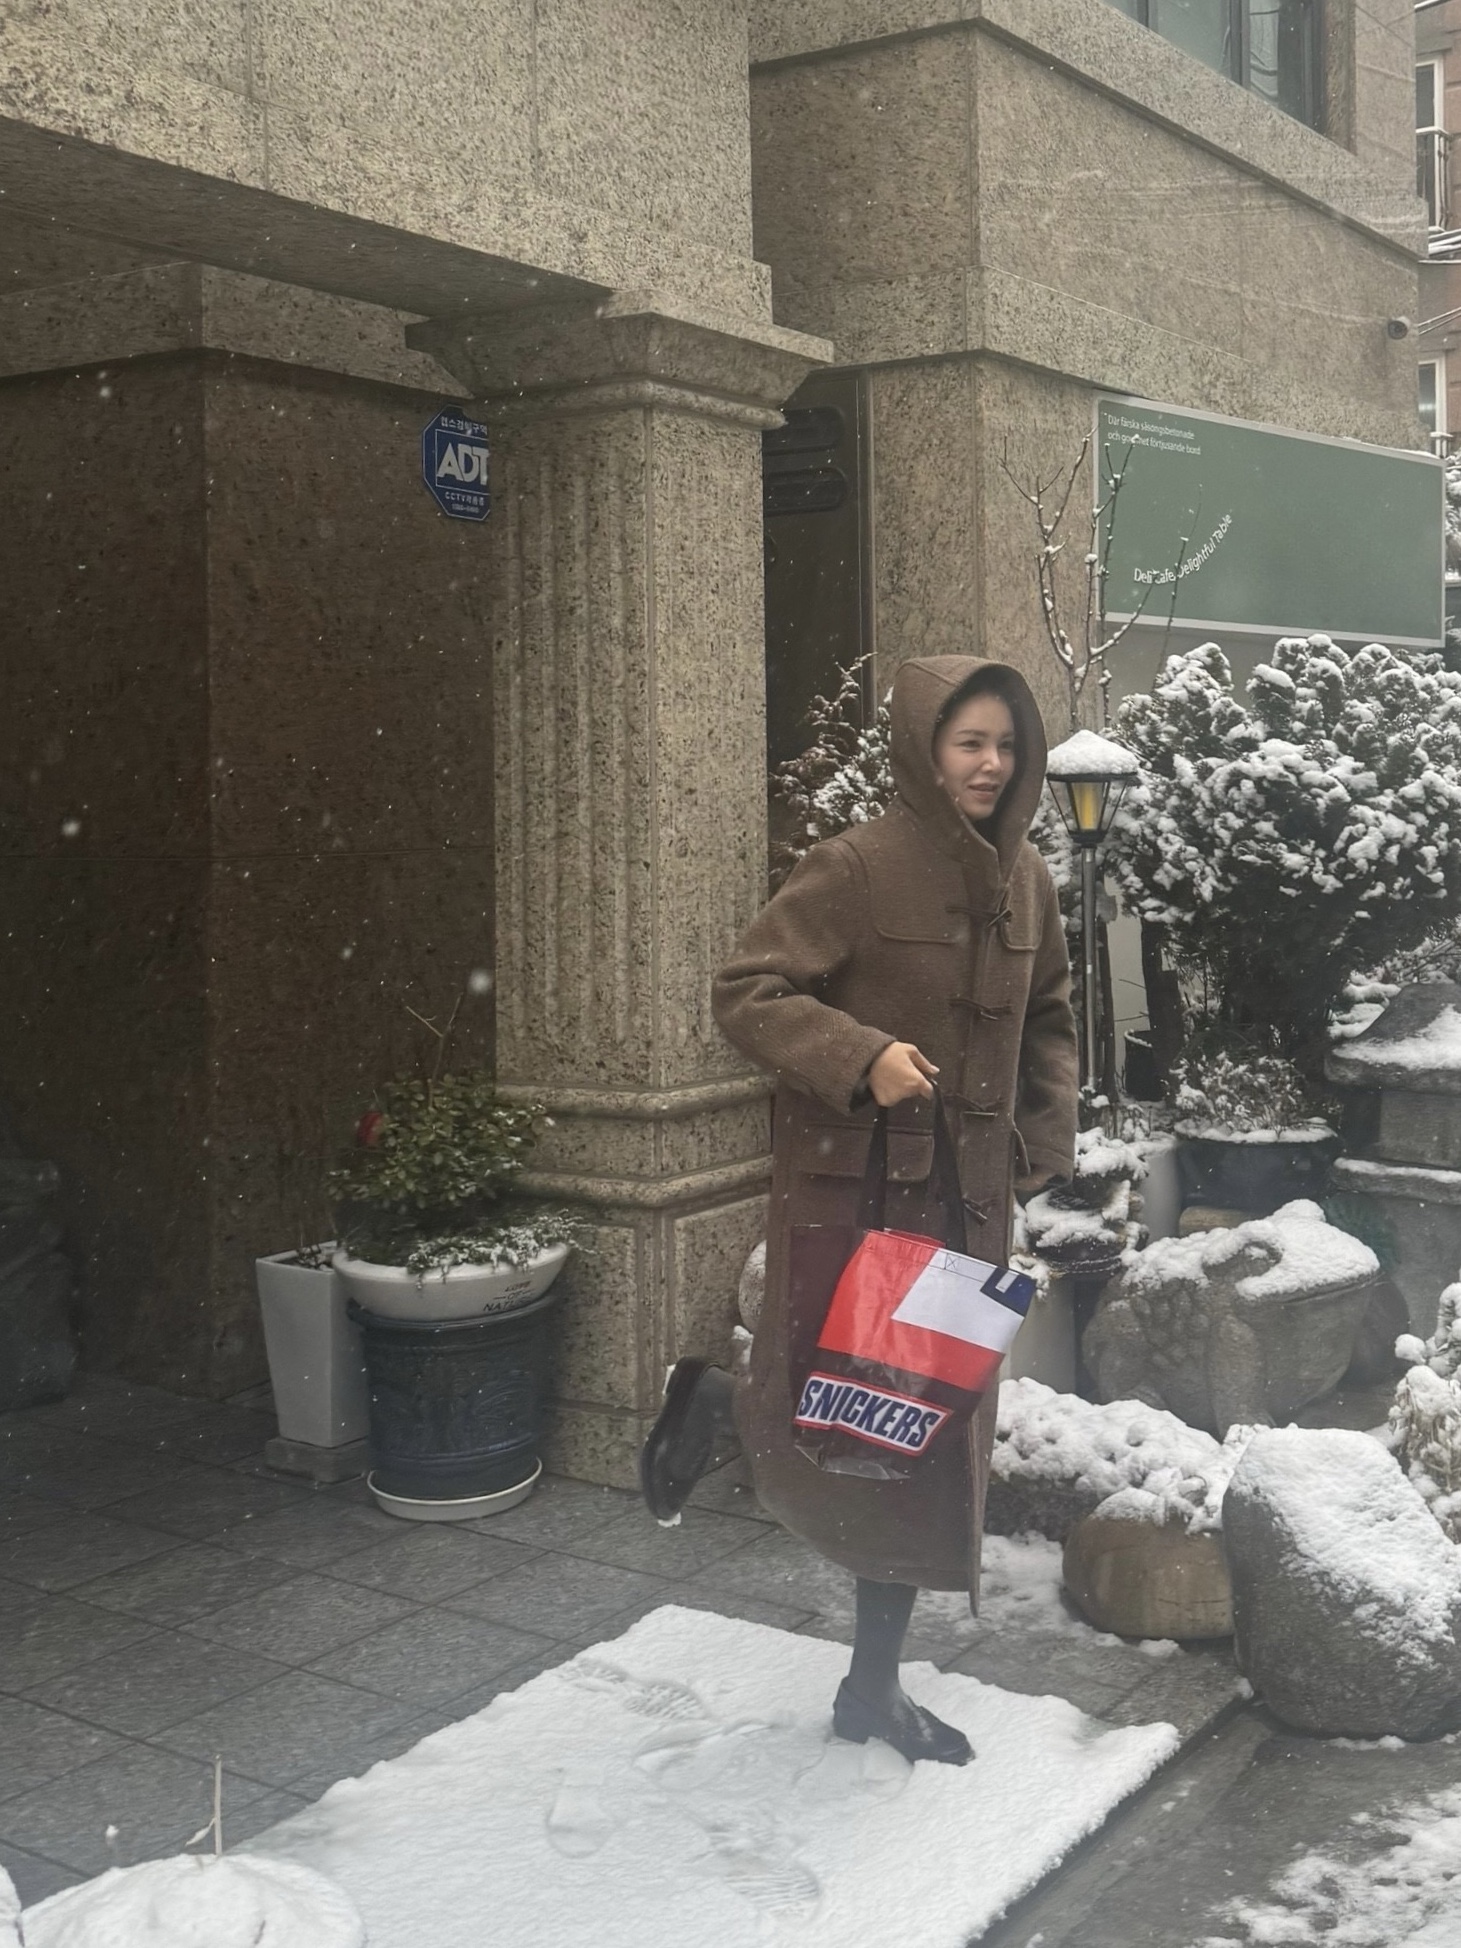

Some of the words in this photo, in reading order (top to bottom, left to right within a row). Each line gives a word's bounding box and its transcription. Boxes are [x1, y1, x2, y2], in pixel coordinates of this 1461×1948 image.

[436, 441, 490, 486] ADT
[1108, 430, 1120, 440] och
[1121, 434, 1150, 446] gomet
[1134, 567, 1152, 584] Deli
[1212, 514, 1232, 543] Table
[797, 1379, 942, 1448] SNICKERS
